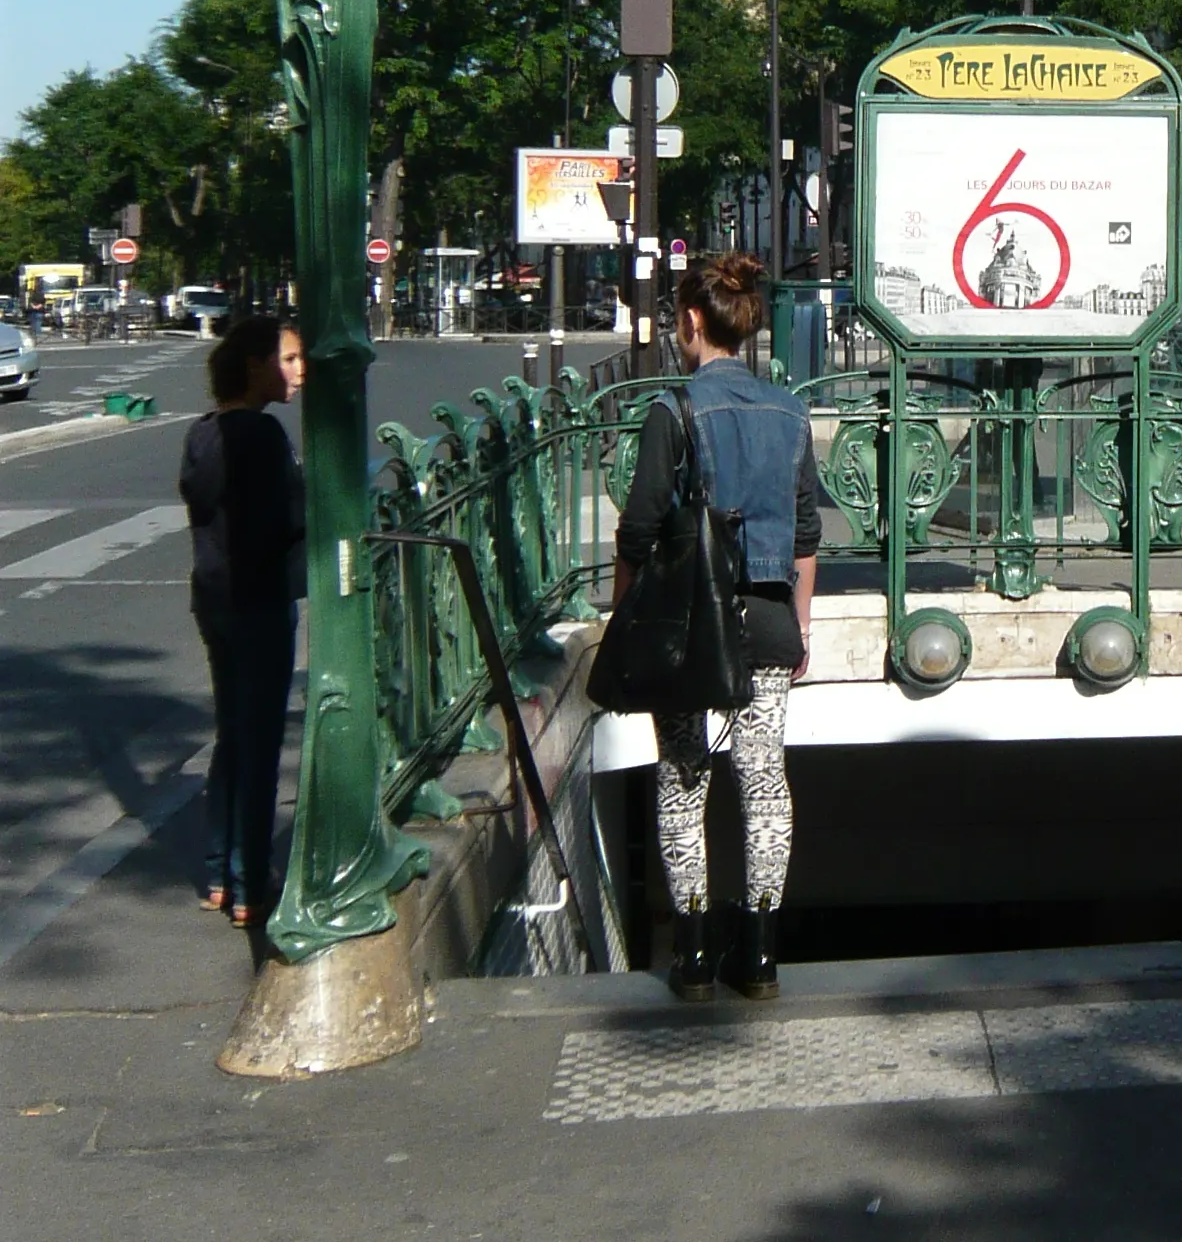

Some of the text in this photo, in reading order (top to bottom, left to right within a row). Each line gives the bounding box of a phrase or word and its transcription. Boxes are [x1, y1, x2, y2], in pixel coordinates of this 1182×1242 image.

[967, 180, 988, 190] LES
[1007, 180, 1046, 190] JOURS
[1050, 180, 1067, 190] DU
[1071, 180, 1112, 191] BAZAR
